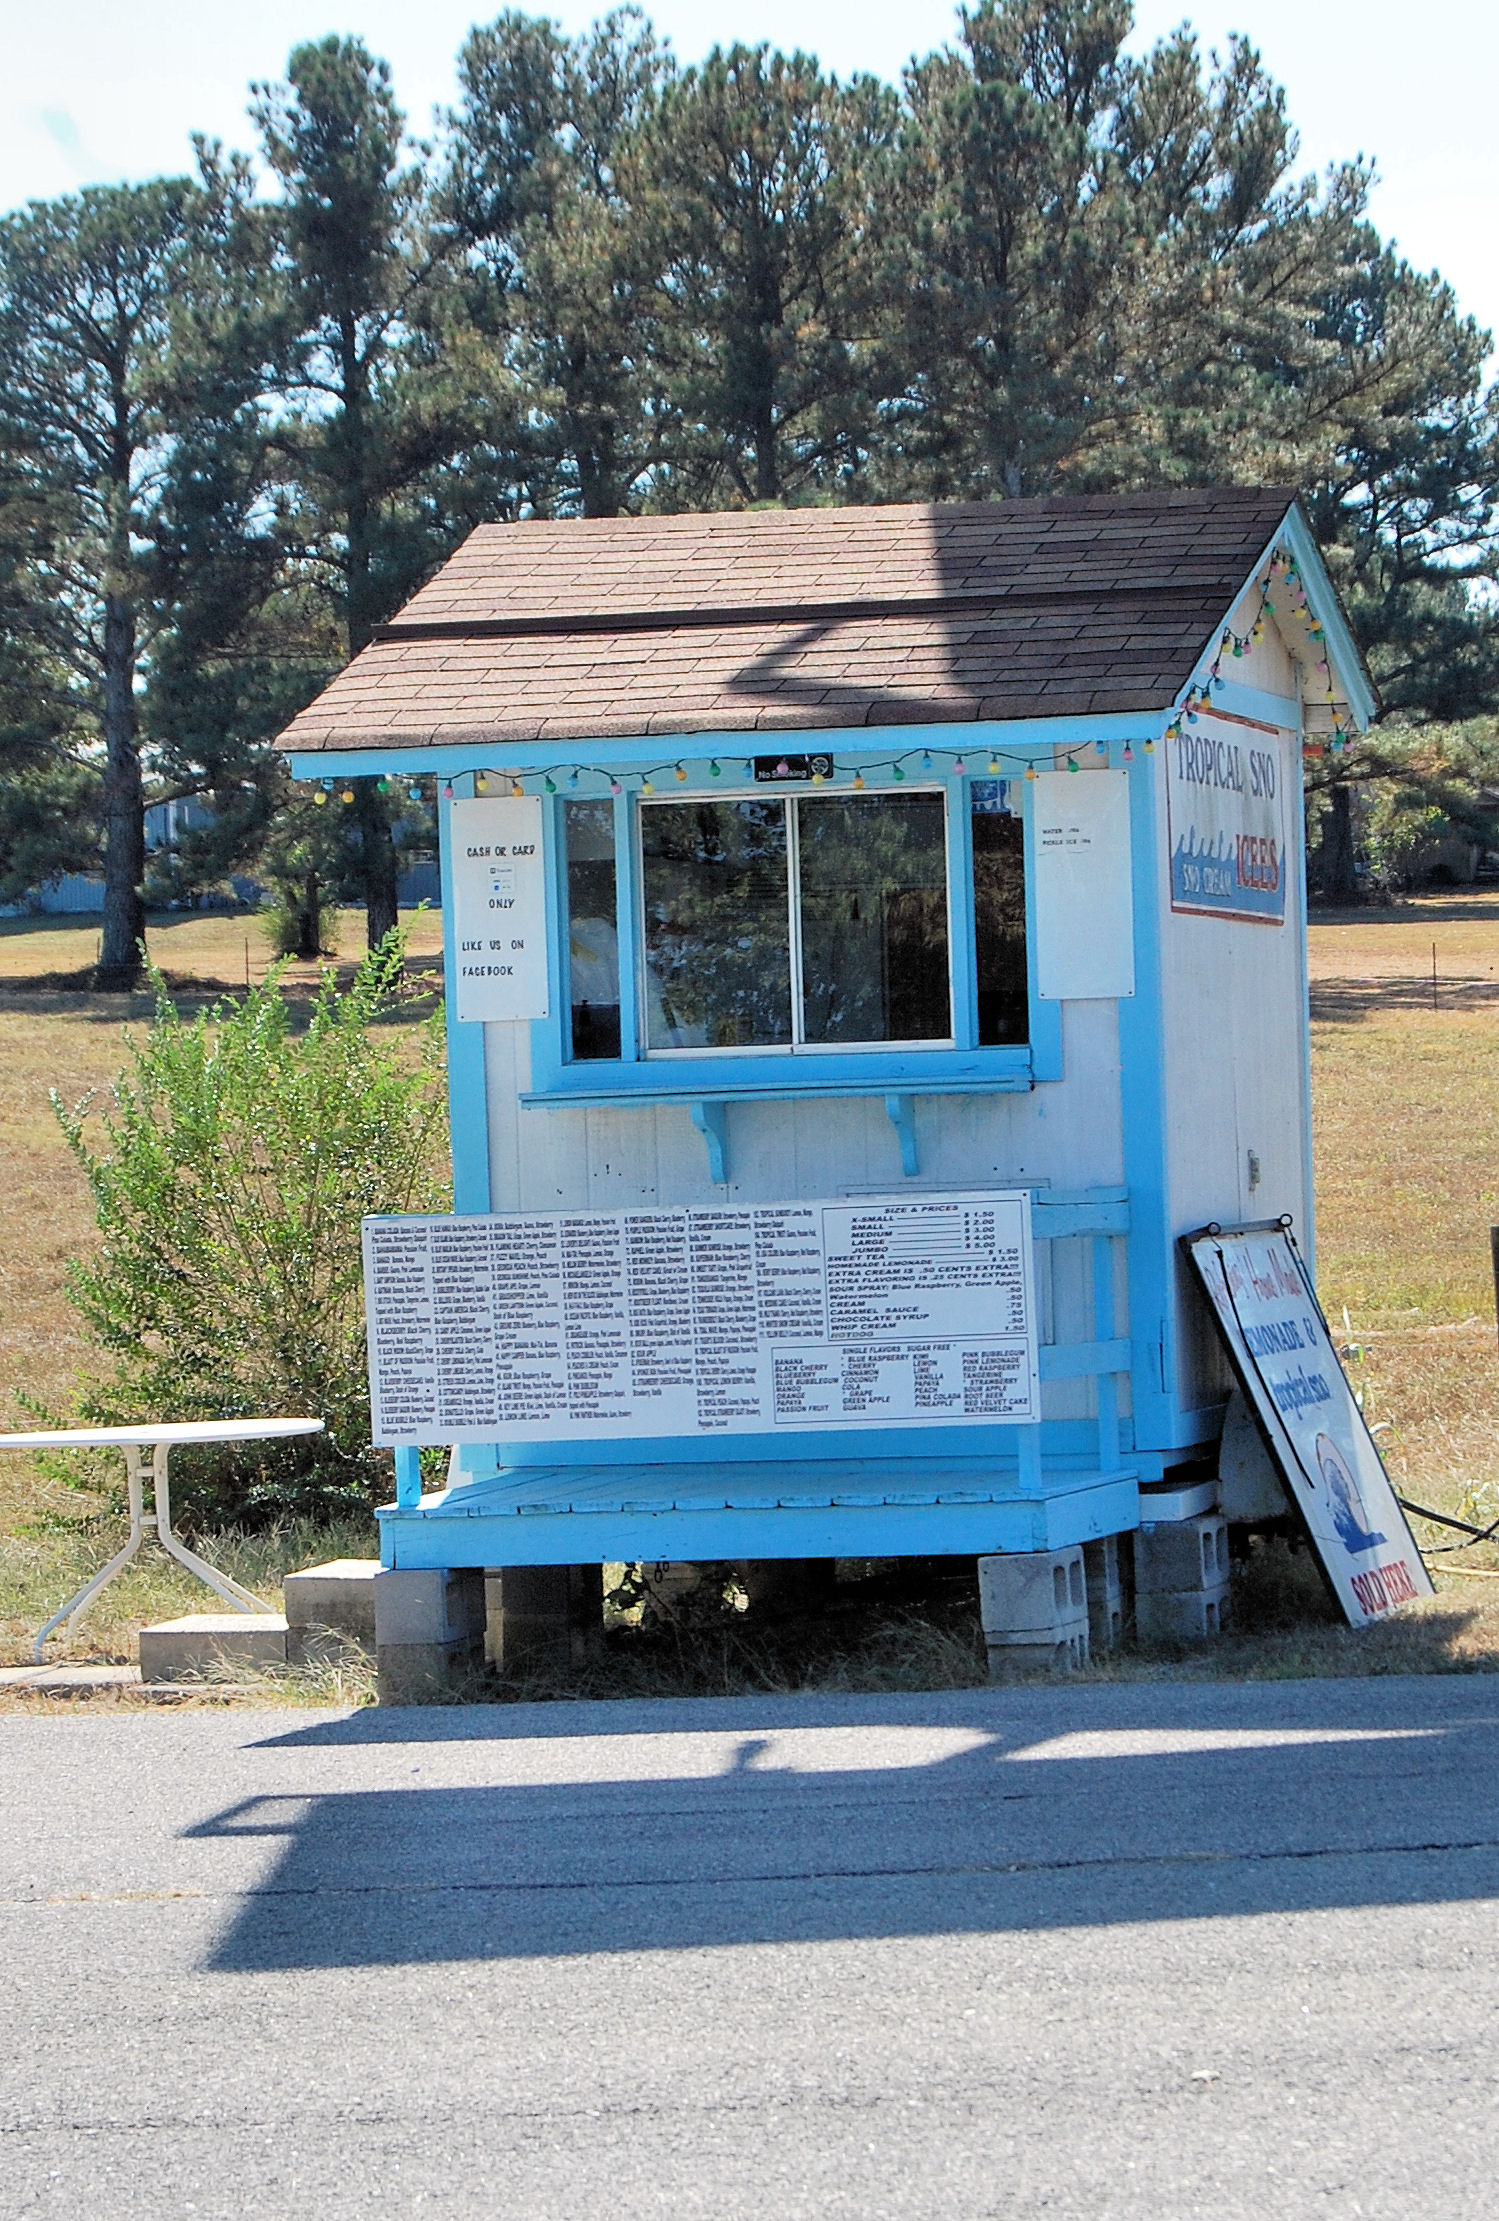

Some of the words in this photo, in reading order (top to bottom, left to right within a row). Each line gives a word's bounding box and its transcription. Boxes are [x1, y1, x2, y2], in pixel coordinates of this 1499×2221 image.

[1175, 733, 1242, 792] TROPICAL
[1250, 750, 1274, 800] SNO
[467, 847, 490, 857] CASH
[495, 846, 506, 856] OR
[512, 845, 535, 856] CARD
[1236, 834, 1278, 891] ICEES
[1183, 863, 1199, 893] SNO
[489, 899, 515, 908] ONLY
[462, 940, 482, 951] LIKE
[490, 940, 501, 950] US
[511, 940, 524, 949] ON
[462, 966, 514, 976] FACEBOOK
[1303, 1318, 1317, 1346] &
[1351, 1570, 1388, 1616] SOLD
[1379, 1560, 1418, 1608] HERE
